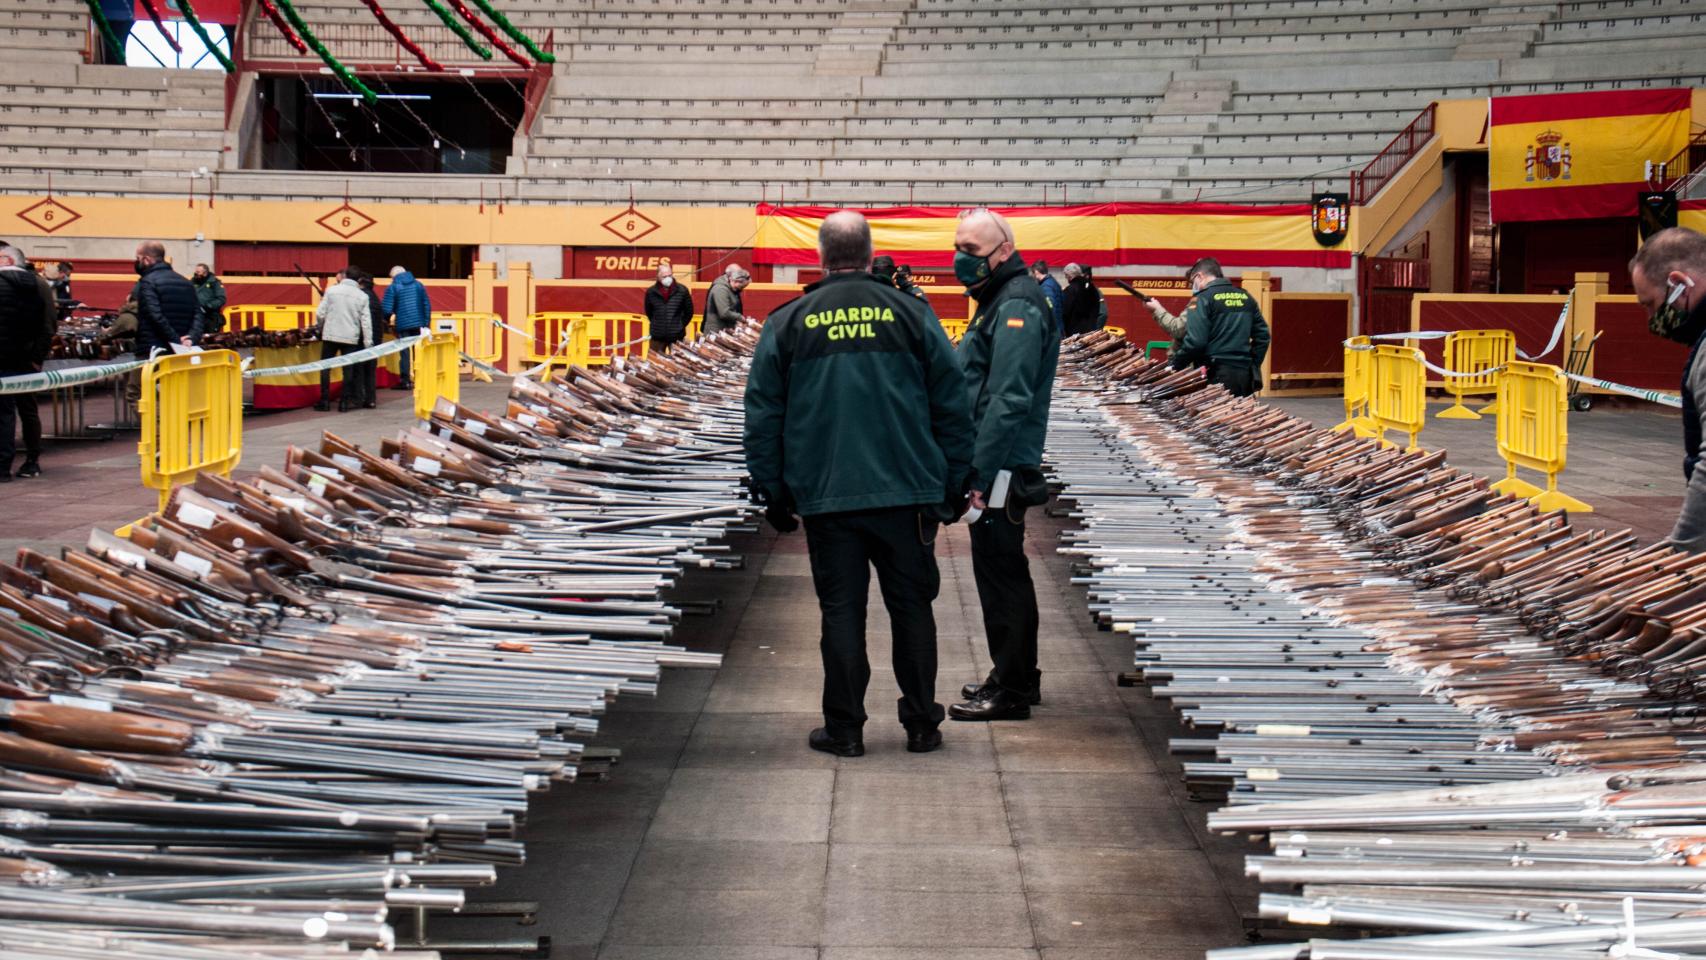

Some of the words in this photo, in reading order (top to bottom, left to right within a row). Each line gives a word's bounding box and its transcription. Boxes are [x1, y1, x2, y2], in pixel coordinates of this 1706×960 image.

[44, 211, 54, 222] 6
[342, 217, 351, 228] 6
[626, 220, 635, 231] 6
[595, 256, 671, 270] TORILES
[1132, 280, 1173, 288] SERVICIO
[1174, 280, 1187, 288] DE
[1213, 292, 1249, 301] GUARDIA
[1224, 299, 1244, 308] CIVIL
[804, 306, 895, 329] GUARDIA
[827, 322, 876, 340] CIVIL
